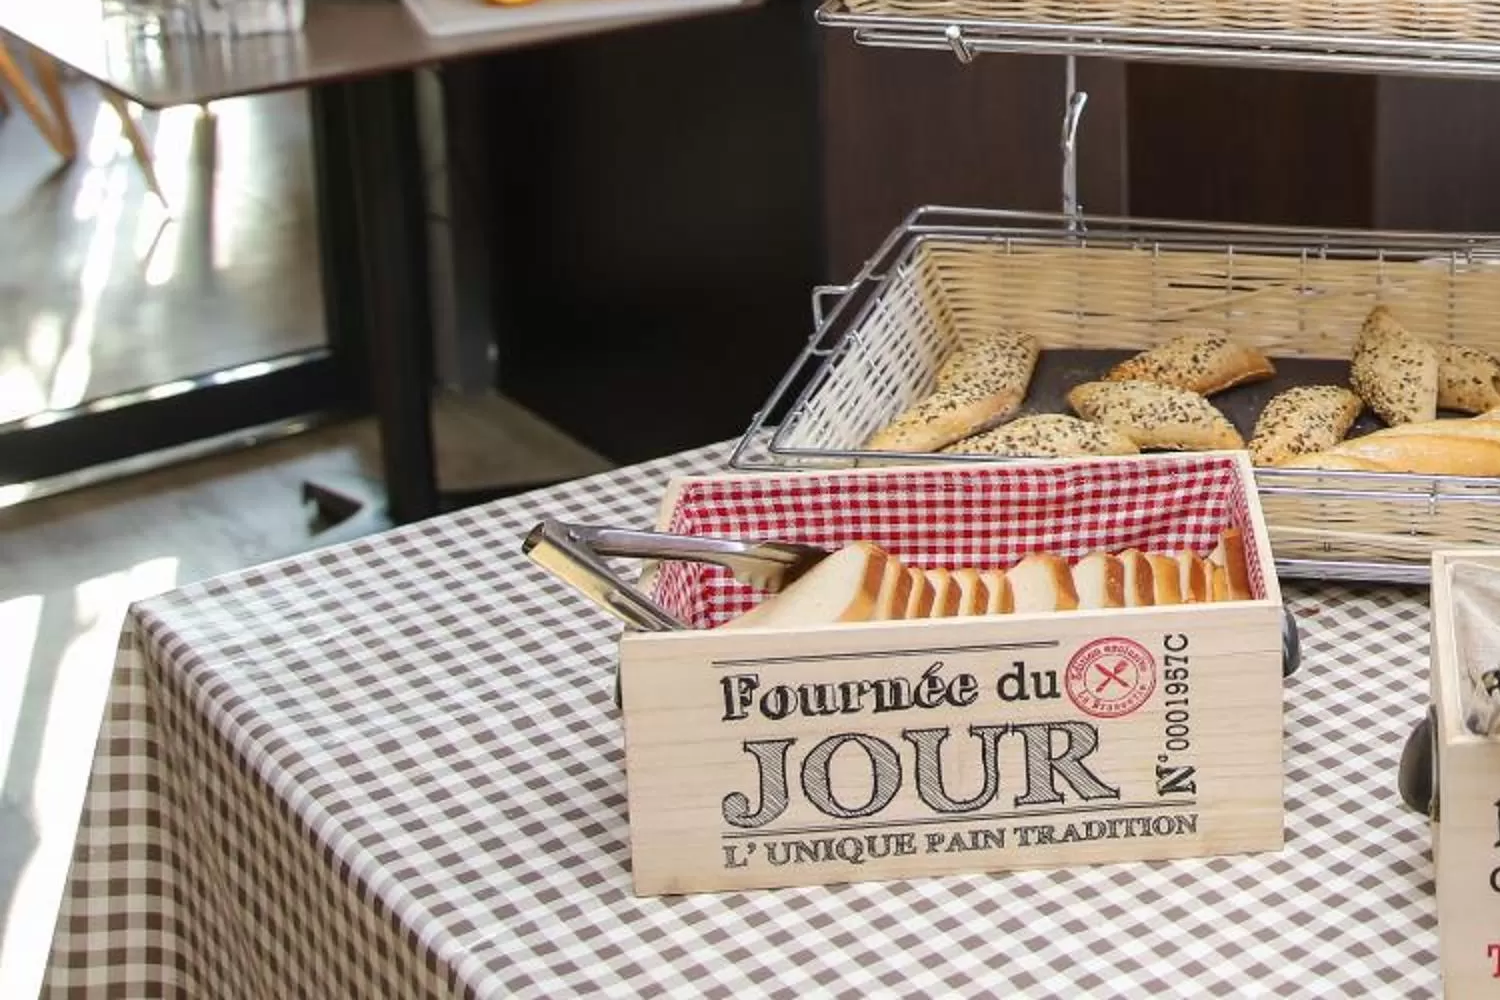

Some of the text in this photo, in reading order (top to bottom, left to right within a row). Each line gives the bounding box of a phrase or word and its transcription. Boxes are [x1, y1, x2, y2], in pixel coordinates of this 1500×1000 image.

[721, 660, 1061, 722] Fournée du
[720, 719, 1120, 829] JOUR
[926, 829, 1006, 854] PAIN
[1014, 813, 1198, 847] TRADITION
